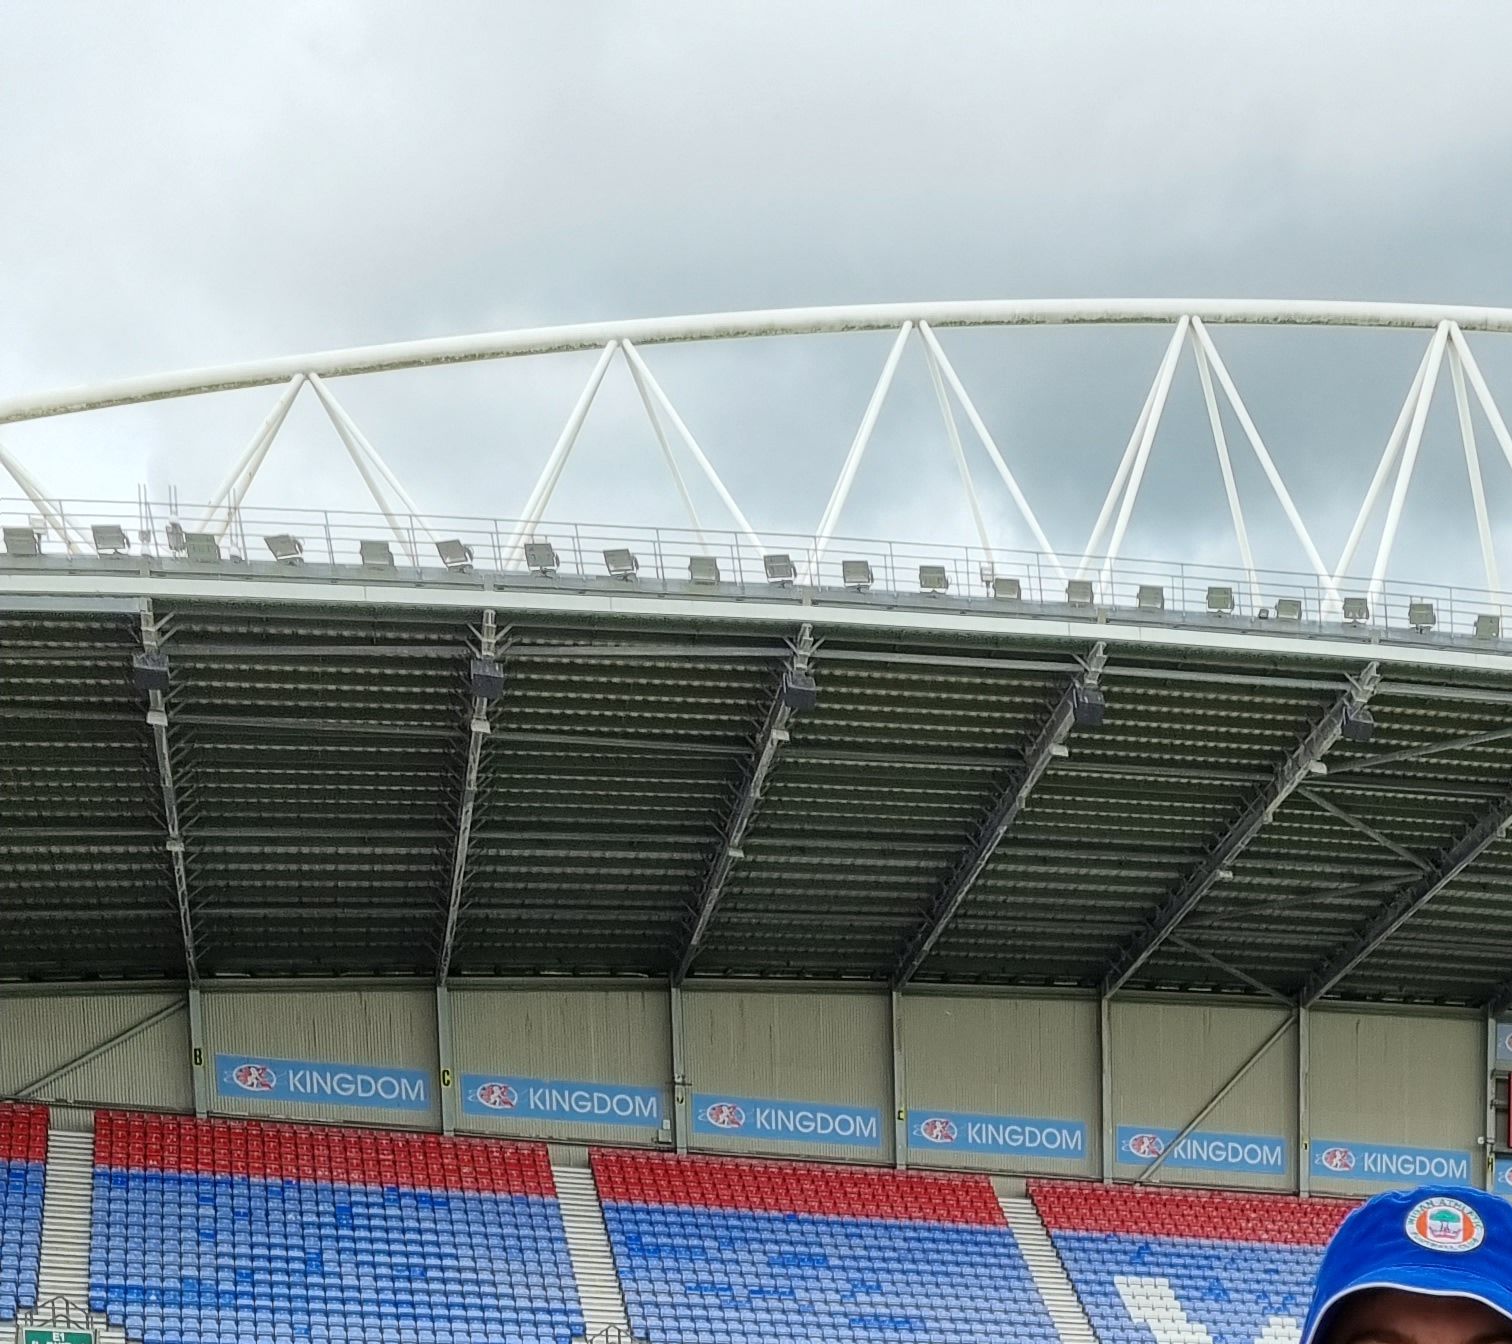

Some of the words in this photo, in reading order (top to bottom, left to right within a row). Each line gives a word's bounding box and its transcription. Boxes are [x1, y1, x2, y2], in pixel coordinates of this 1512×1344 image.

[194, 1048, 203, 1066] B
[287, 1069, 425, 1102] KINGDOM
[441, 1069, 451, 1087] C
[529, 1087, 658, 1119] KINGDOM
[755, 1107, 877, 1138] KINGDOM
[967, 1121, 1083, 1151] KINGDOM
[1173, 1139, 1282, 1166] KINGDOM
[1363, 1152, 1468, 1180] KINGDOM
[52, 1331, 65, 1342] E1
